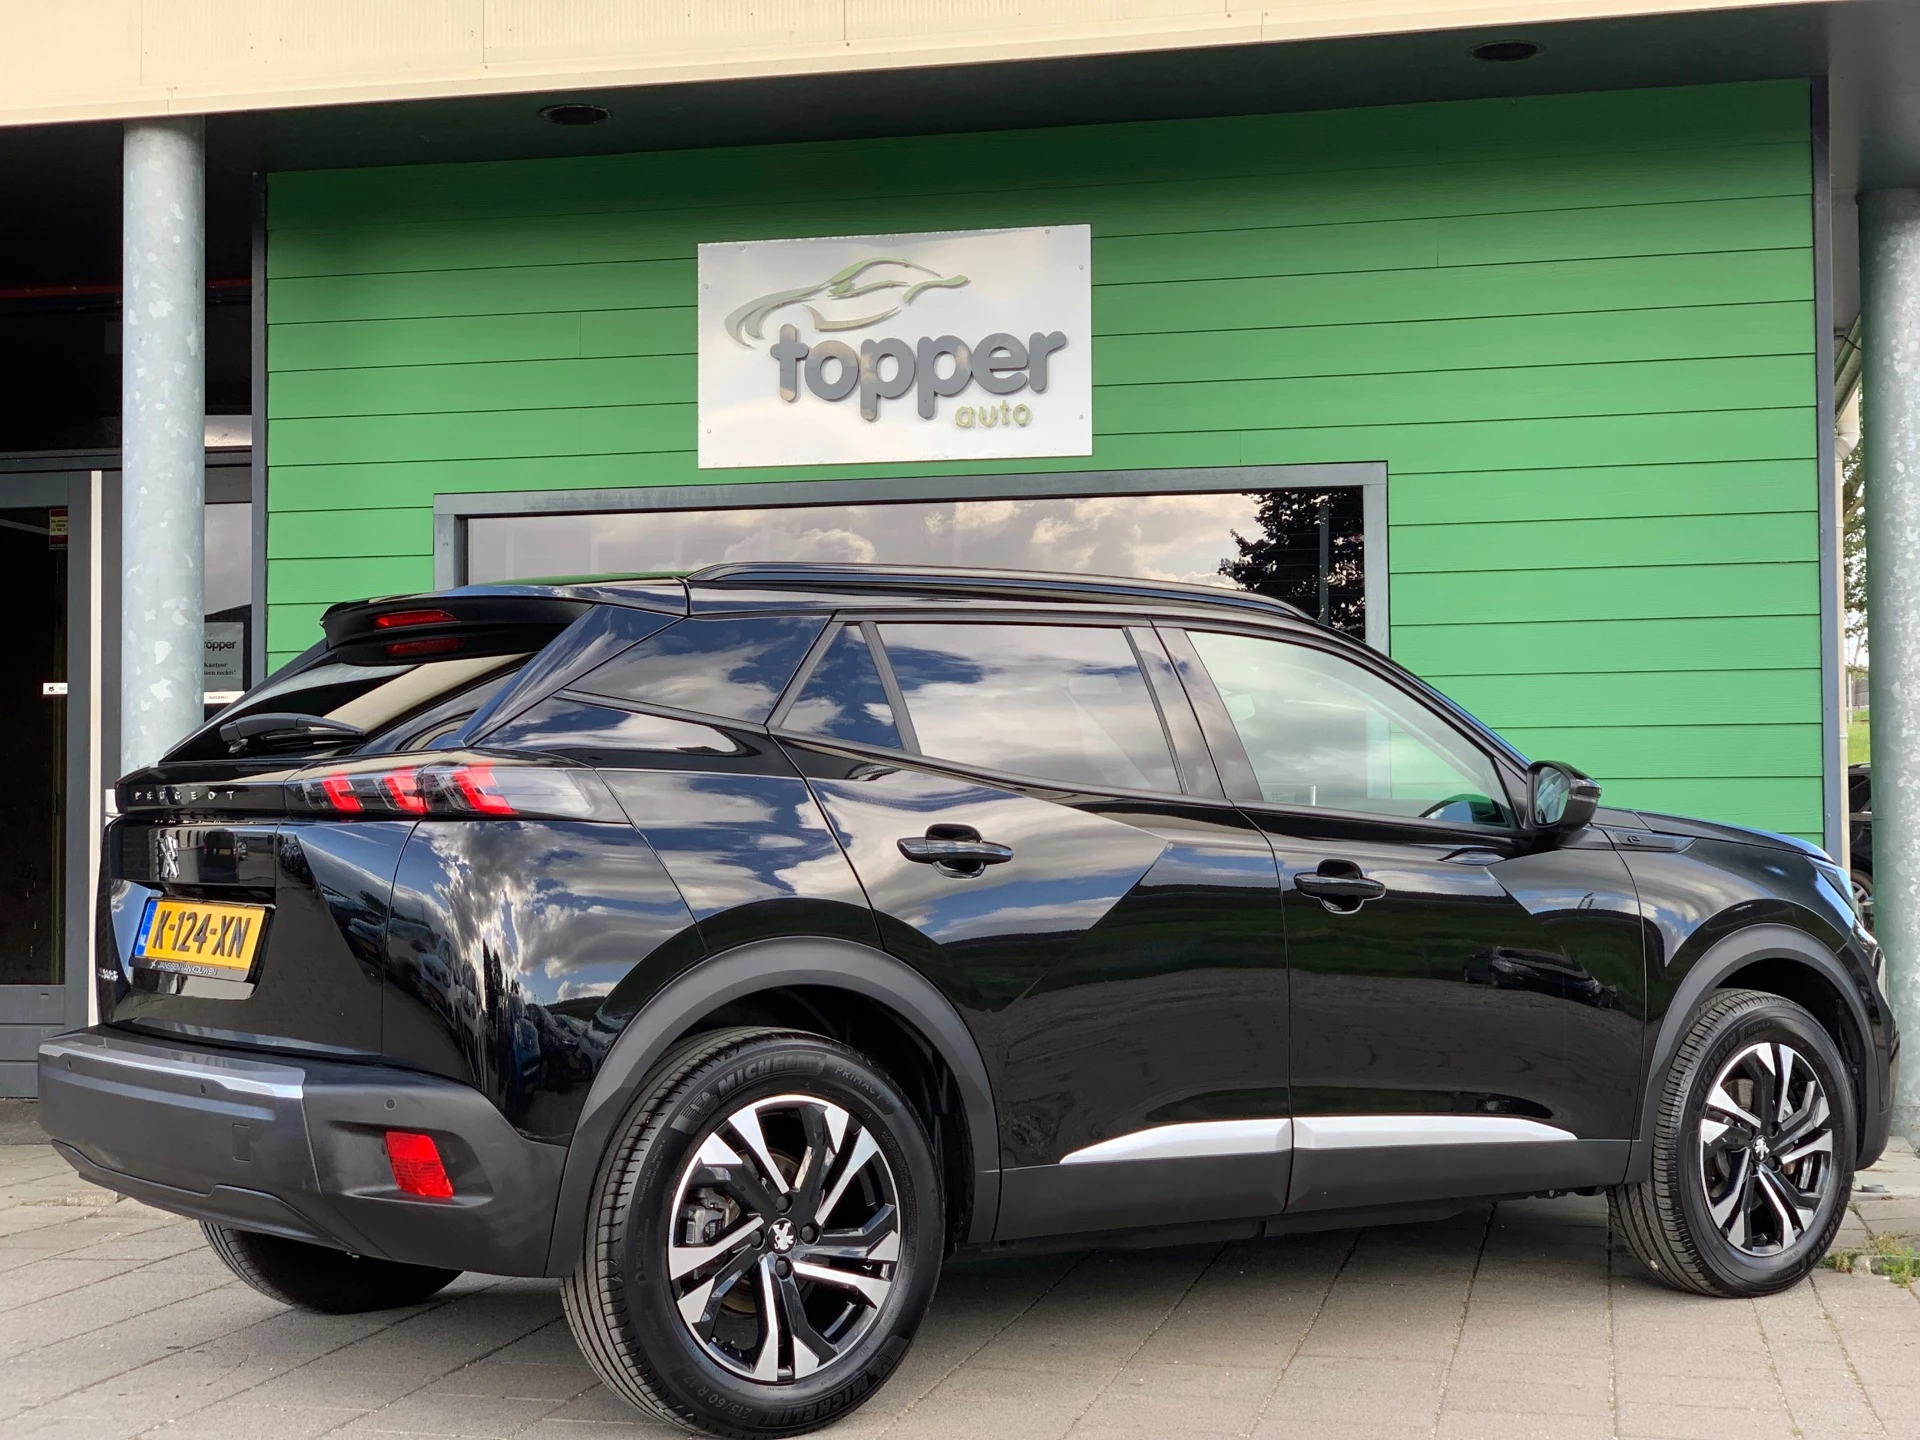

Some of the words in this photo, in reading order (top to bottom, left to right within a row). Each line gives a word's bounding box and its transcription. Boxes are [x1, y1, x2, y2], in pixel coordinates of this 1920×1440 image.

[770, 323, 1067, 422] topper
[955, 400, 1031, 428] auto
[134, 790, 235, 800] PEUGEOT
[152, 910, 251, 959] K-124-XN
[718, 1054, 822, 1095] MICHELIN
